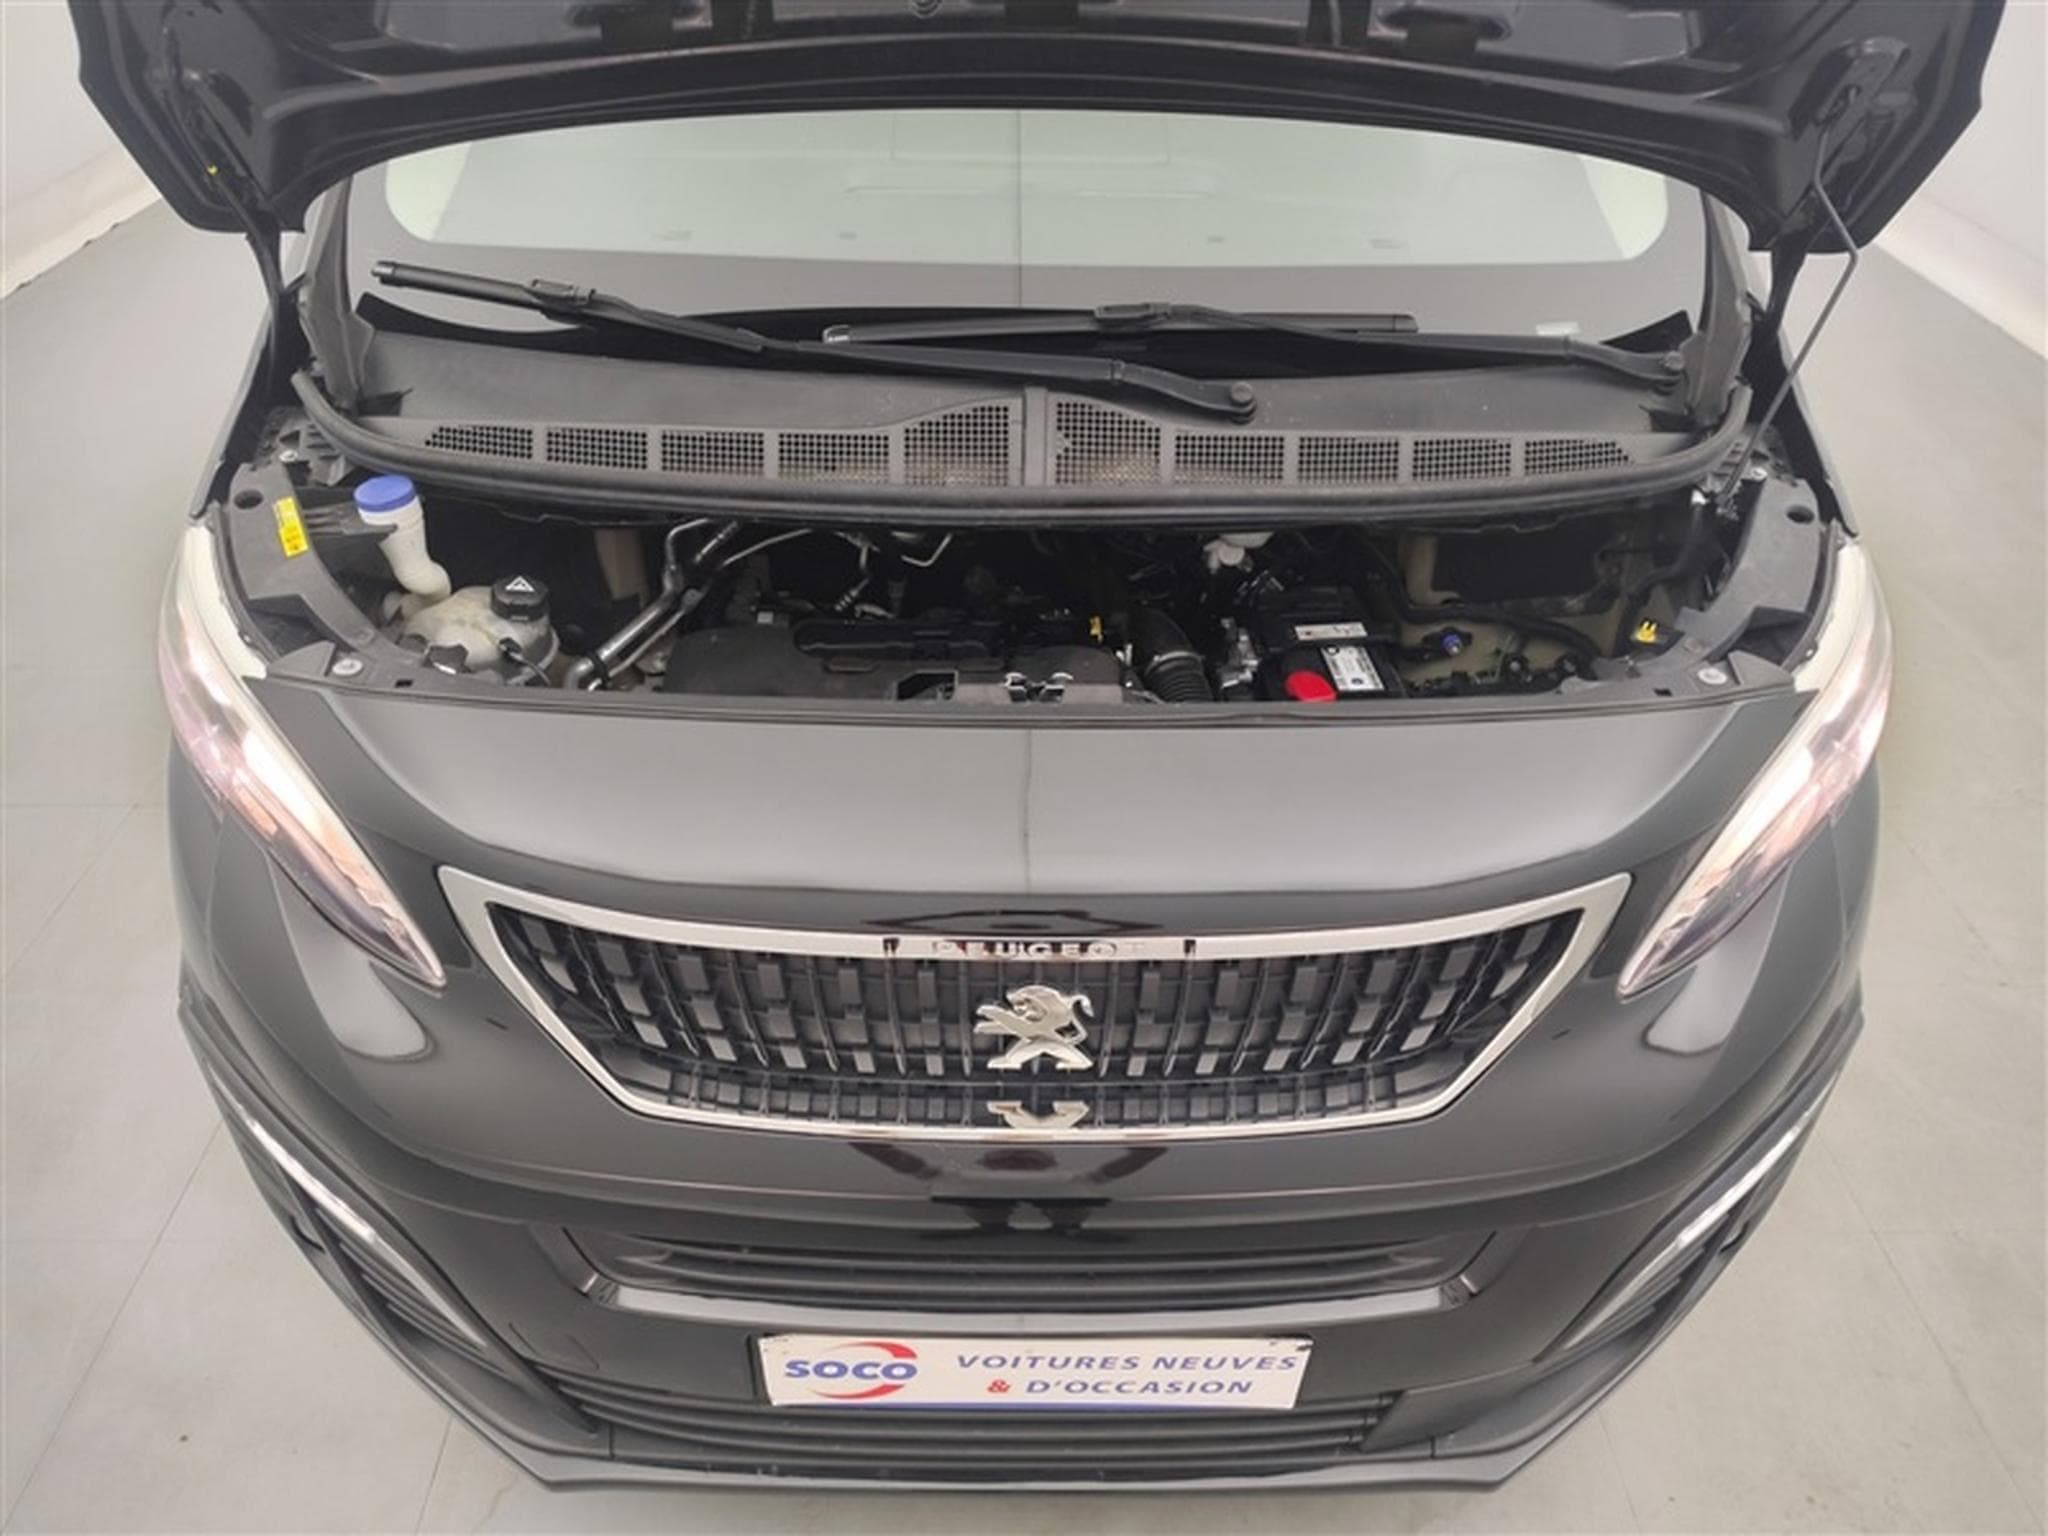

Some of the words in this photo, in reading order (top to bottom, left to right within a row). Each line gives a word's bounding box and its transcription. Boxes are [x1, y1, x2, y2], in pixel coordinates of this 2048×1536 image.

[785, 1359, 918, 1380] SOCO
[957, 1355, 1140, 1370] VOITURES
[1153, 1356, 1297, 1371] NEUVES
[986, 1379, 1011, 1393] &
[1025, 1379, 1254, 1394] D'OCCASION
